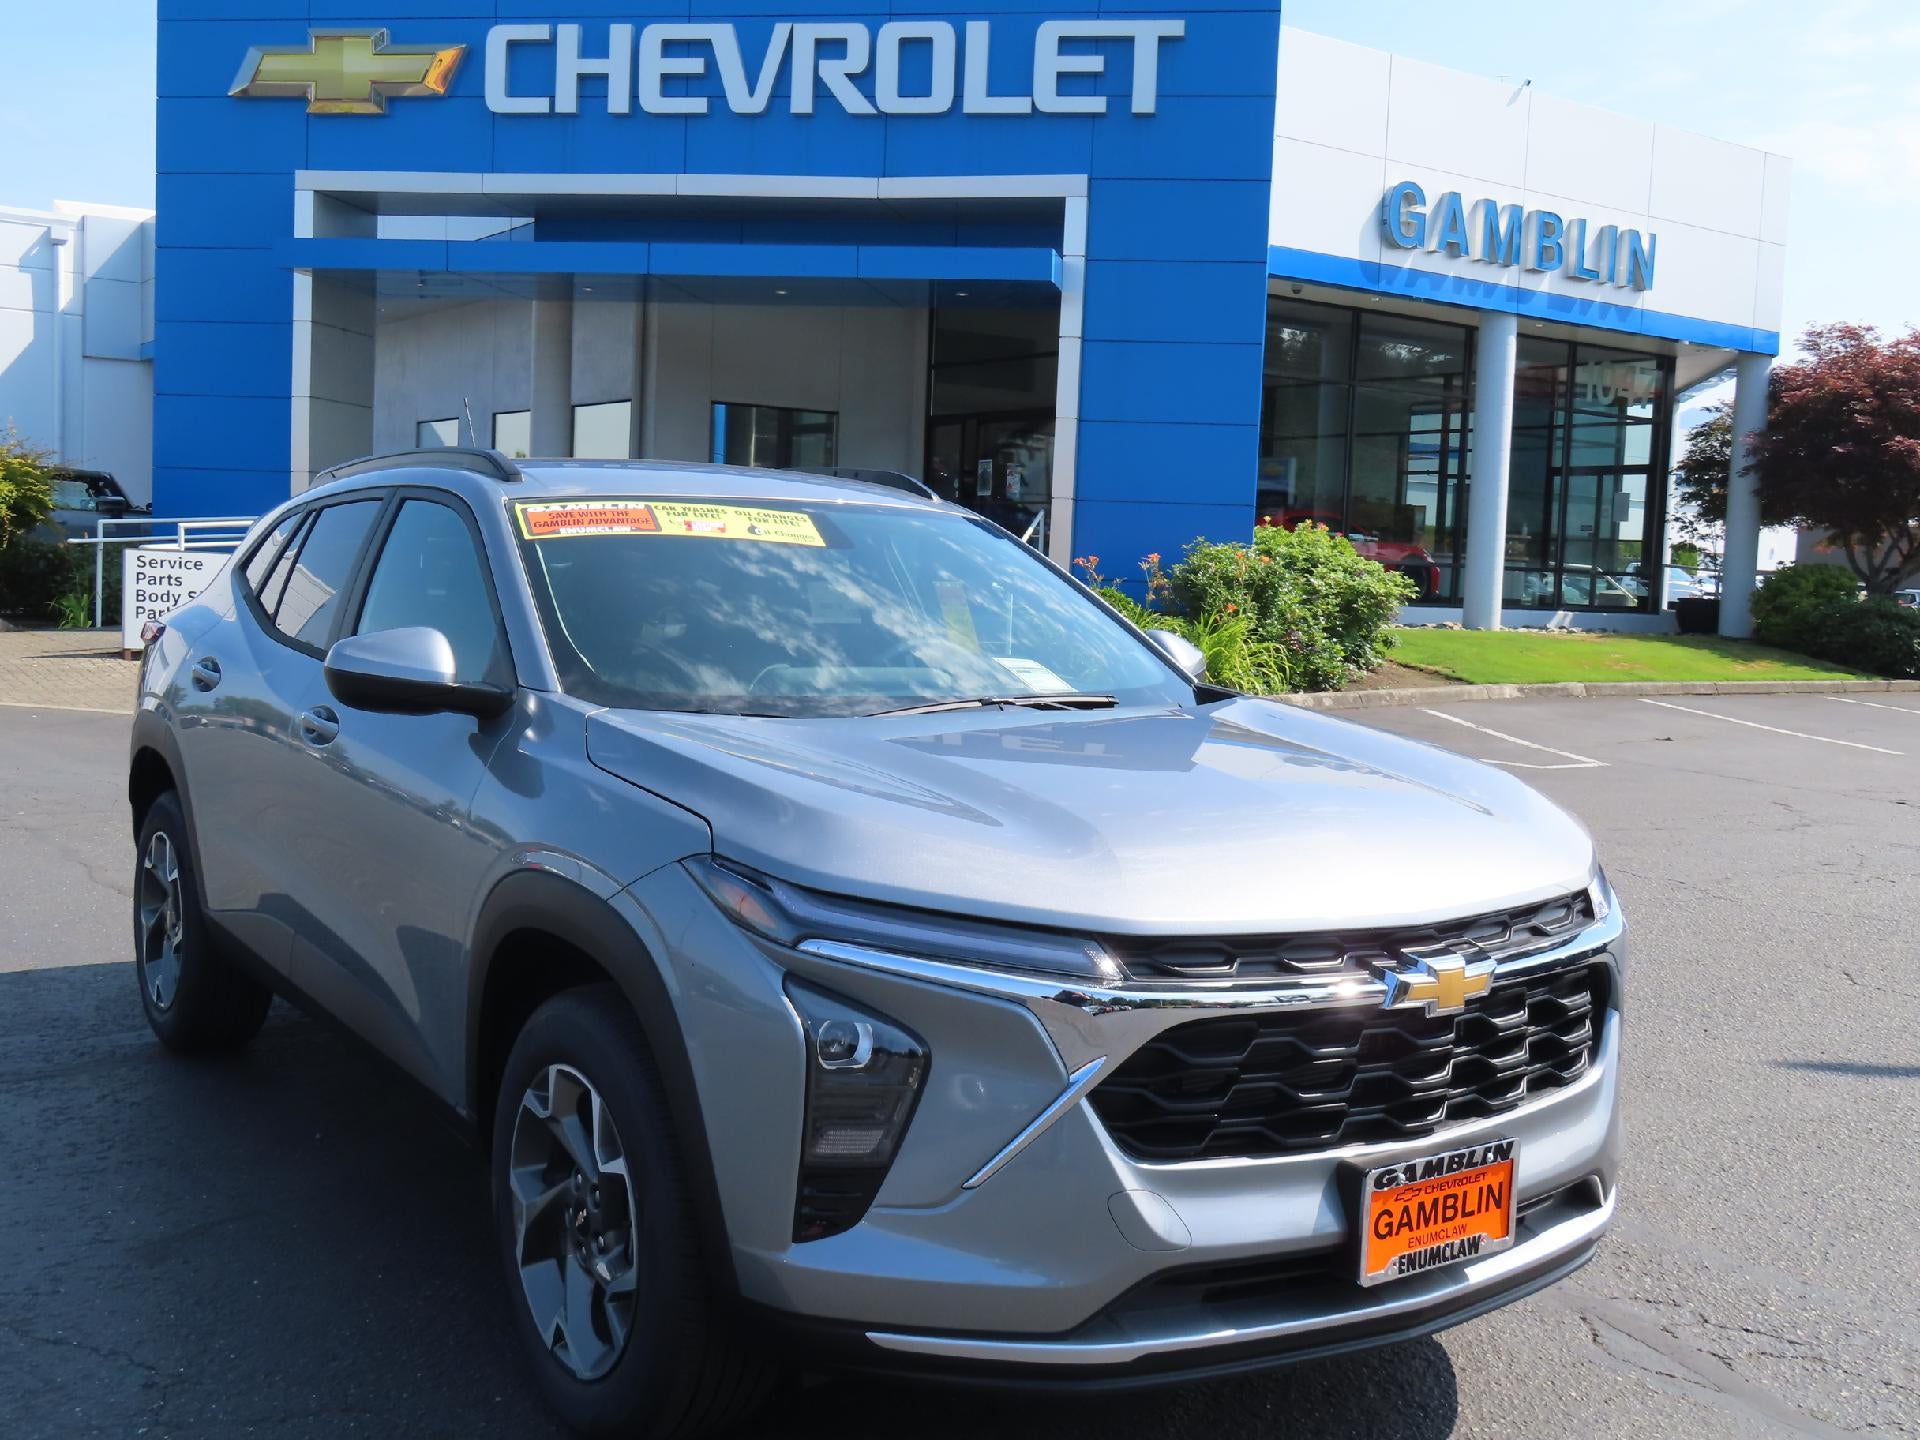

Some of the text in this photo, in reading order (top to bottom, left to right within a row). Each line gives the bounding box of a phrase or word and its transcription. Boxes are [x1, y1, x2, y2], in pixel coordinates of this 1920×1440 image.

[484, 18, 1186, 116] CHEVROLET
[1381, 181, 1657, 291] GAMBLIN
[548, 511, 576, 520] SAVE
[578, 511, 607, 519] WITH
[653, 504, 677, 512] CAR
[756, 511, 808, 523] CHANGES
[533, 517, 653, 528] GAMBLIN ADVANTAGE
[748, 516, 771, 524] FOR
[136, 555, 204, 571] Service
[136, 572, 183, 587] Parts
[136, 589, 182, 607] Body
[1373, 1140, 1514, 1190] GAMBLIN
[1424, 1171, 1488, 1195] CHEVROLET
[1373, 1181, 1504, 1240] GAMBLIN
[1407, 1223, 1468, 1249] ENUMCLAW
[1398, 1235, 1481, 1273] ENUMCLAW
